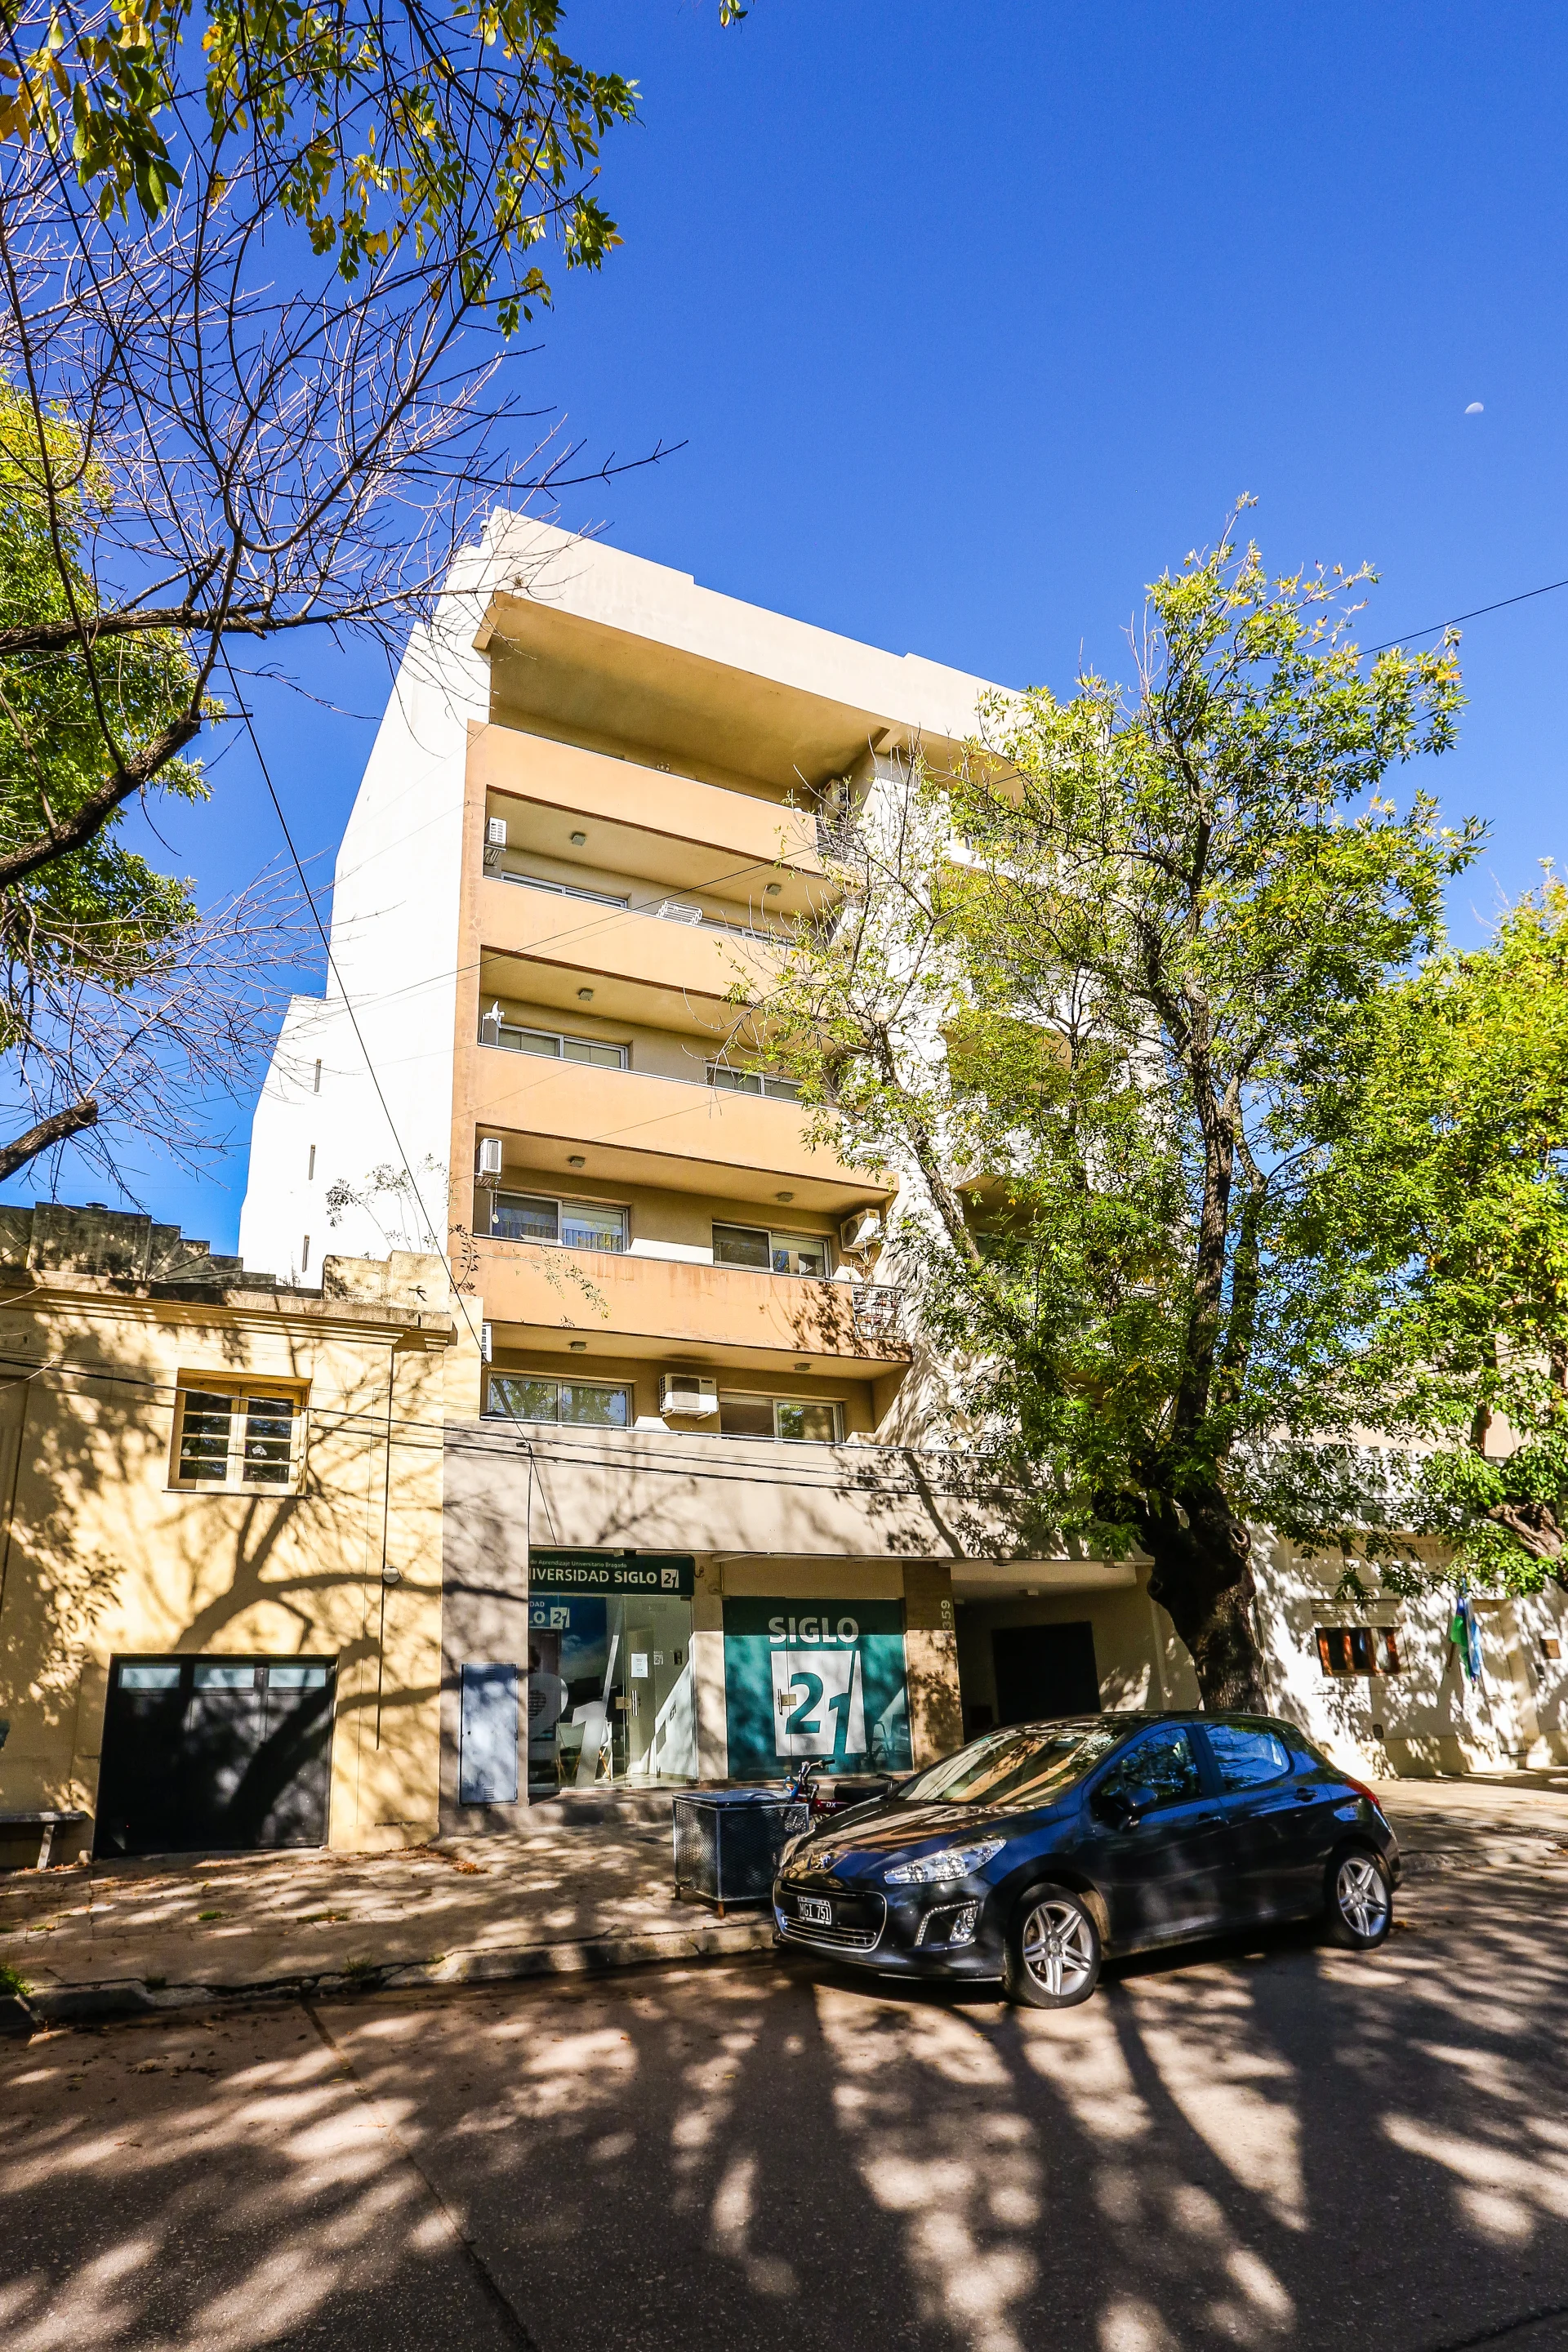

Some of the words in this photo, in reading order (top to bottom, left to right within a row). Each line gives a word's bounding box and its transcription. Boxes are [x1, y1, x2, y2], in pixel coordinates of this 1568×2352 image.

[538, 1559, 571, 1567] Aprendizaje
[605, 1561, 627, 1570] Bragado
[614, 1570, 657, 1584] SIGLO
[662, 1570, 679, 1588] 21
[552, 1608, 569, 1629] 21
[768, 1617, 859, 1644] SIGLO
[785, 1666, 854, 1756] 21
[800, 1903, 813, 1918] MGI
[817, 1905, 830, 1921] 751
